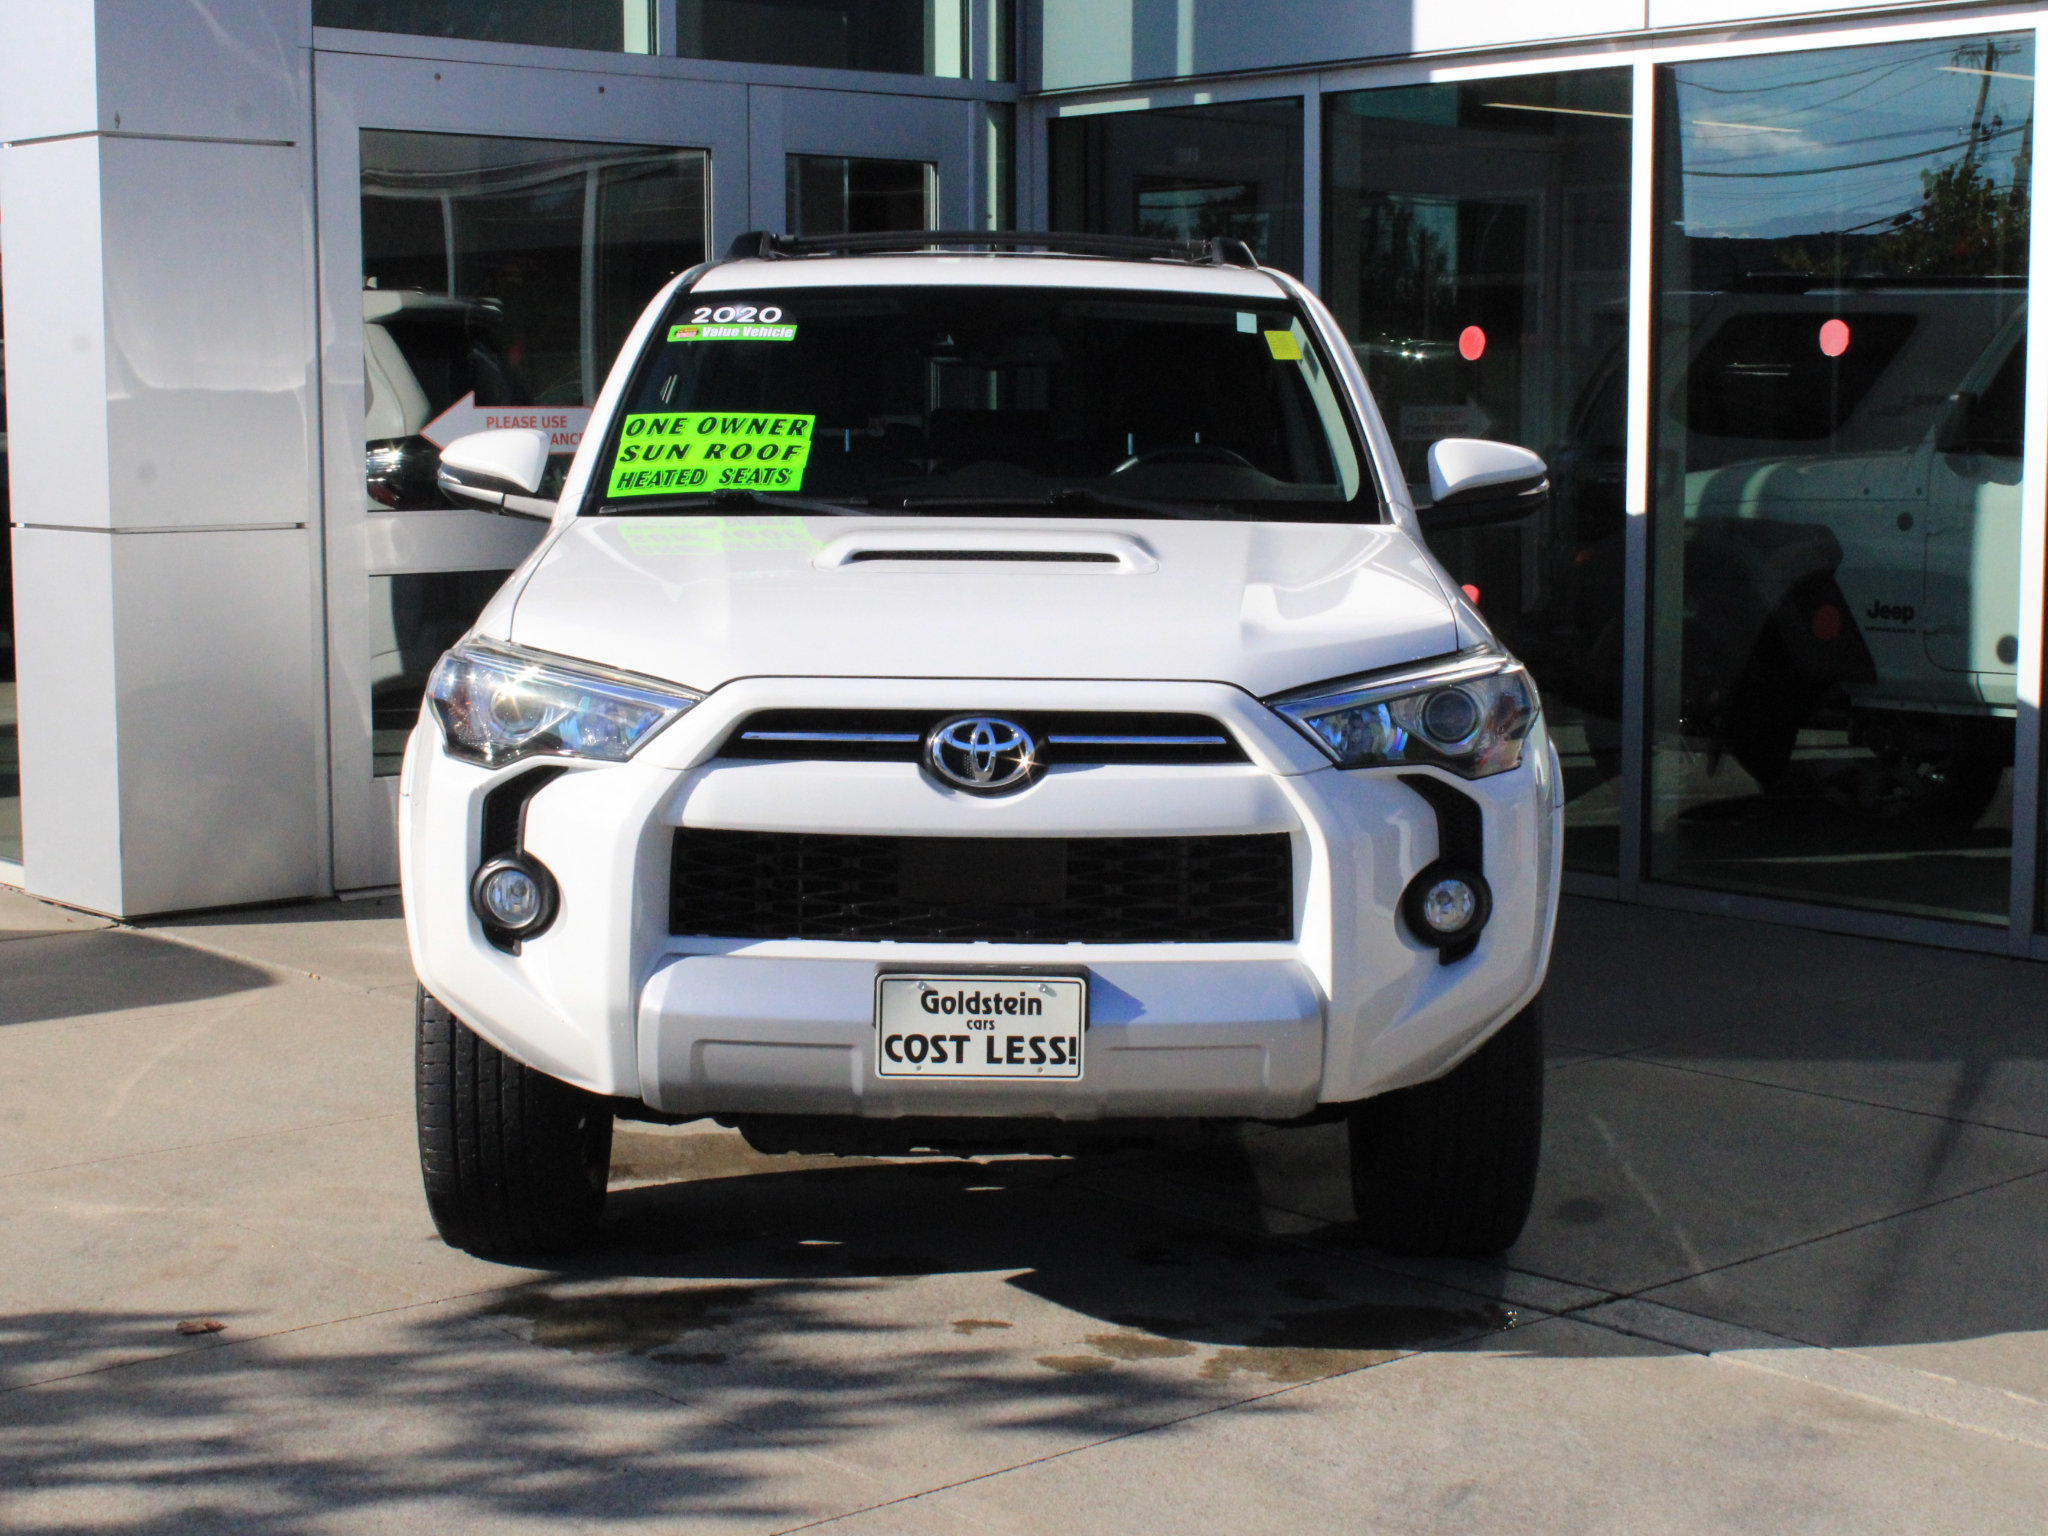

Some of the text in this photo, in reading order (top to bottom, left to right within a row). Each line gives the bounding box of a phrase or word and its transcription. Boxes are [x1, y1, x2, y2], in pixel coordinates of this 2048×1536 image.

[691, 306, 783, 324] 2020
[702, 326, 739, 338] Value
[742, 326, 794, 338] Vehicle
[486, 415, 567, 429] PLEASE USE
[625, 416, 809, 437] ONE OWNER
[619, 443, 802, 463] SUN ROOF
[616, 467, 792, 489] HEATED SEATS
[1866, 601, 1915, 624] Jeep
[920, 990, 1043, 1016] Goldstein
[966, 1019, 995, 1031] cars
[884, 1033, 1077, 1065] COST LESS!
